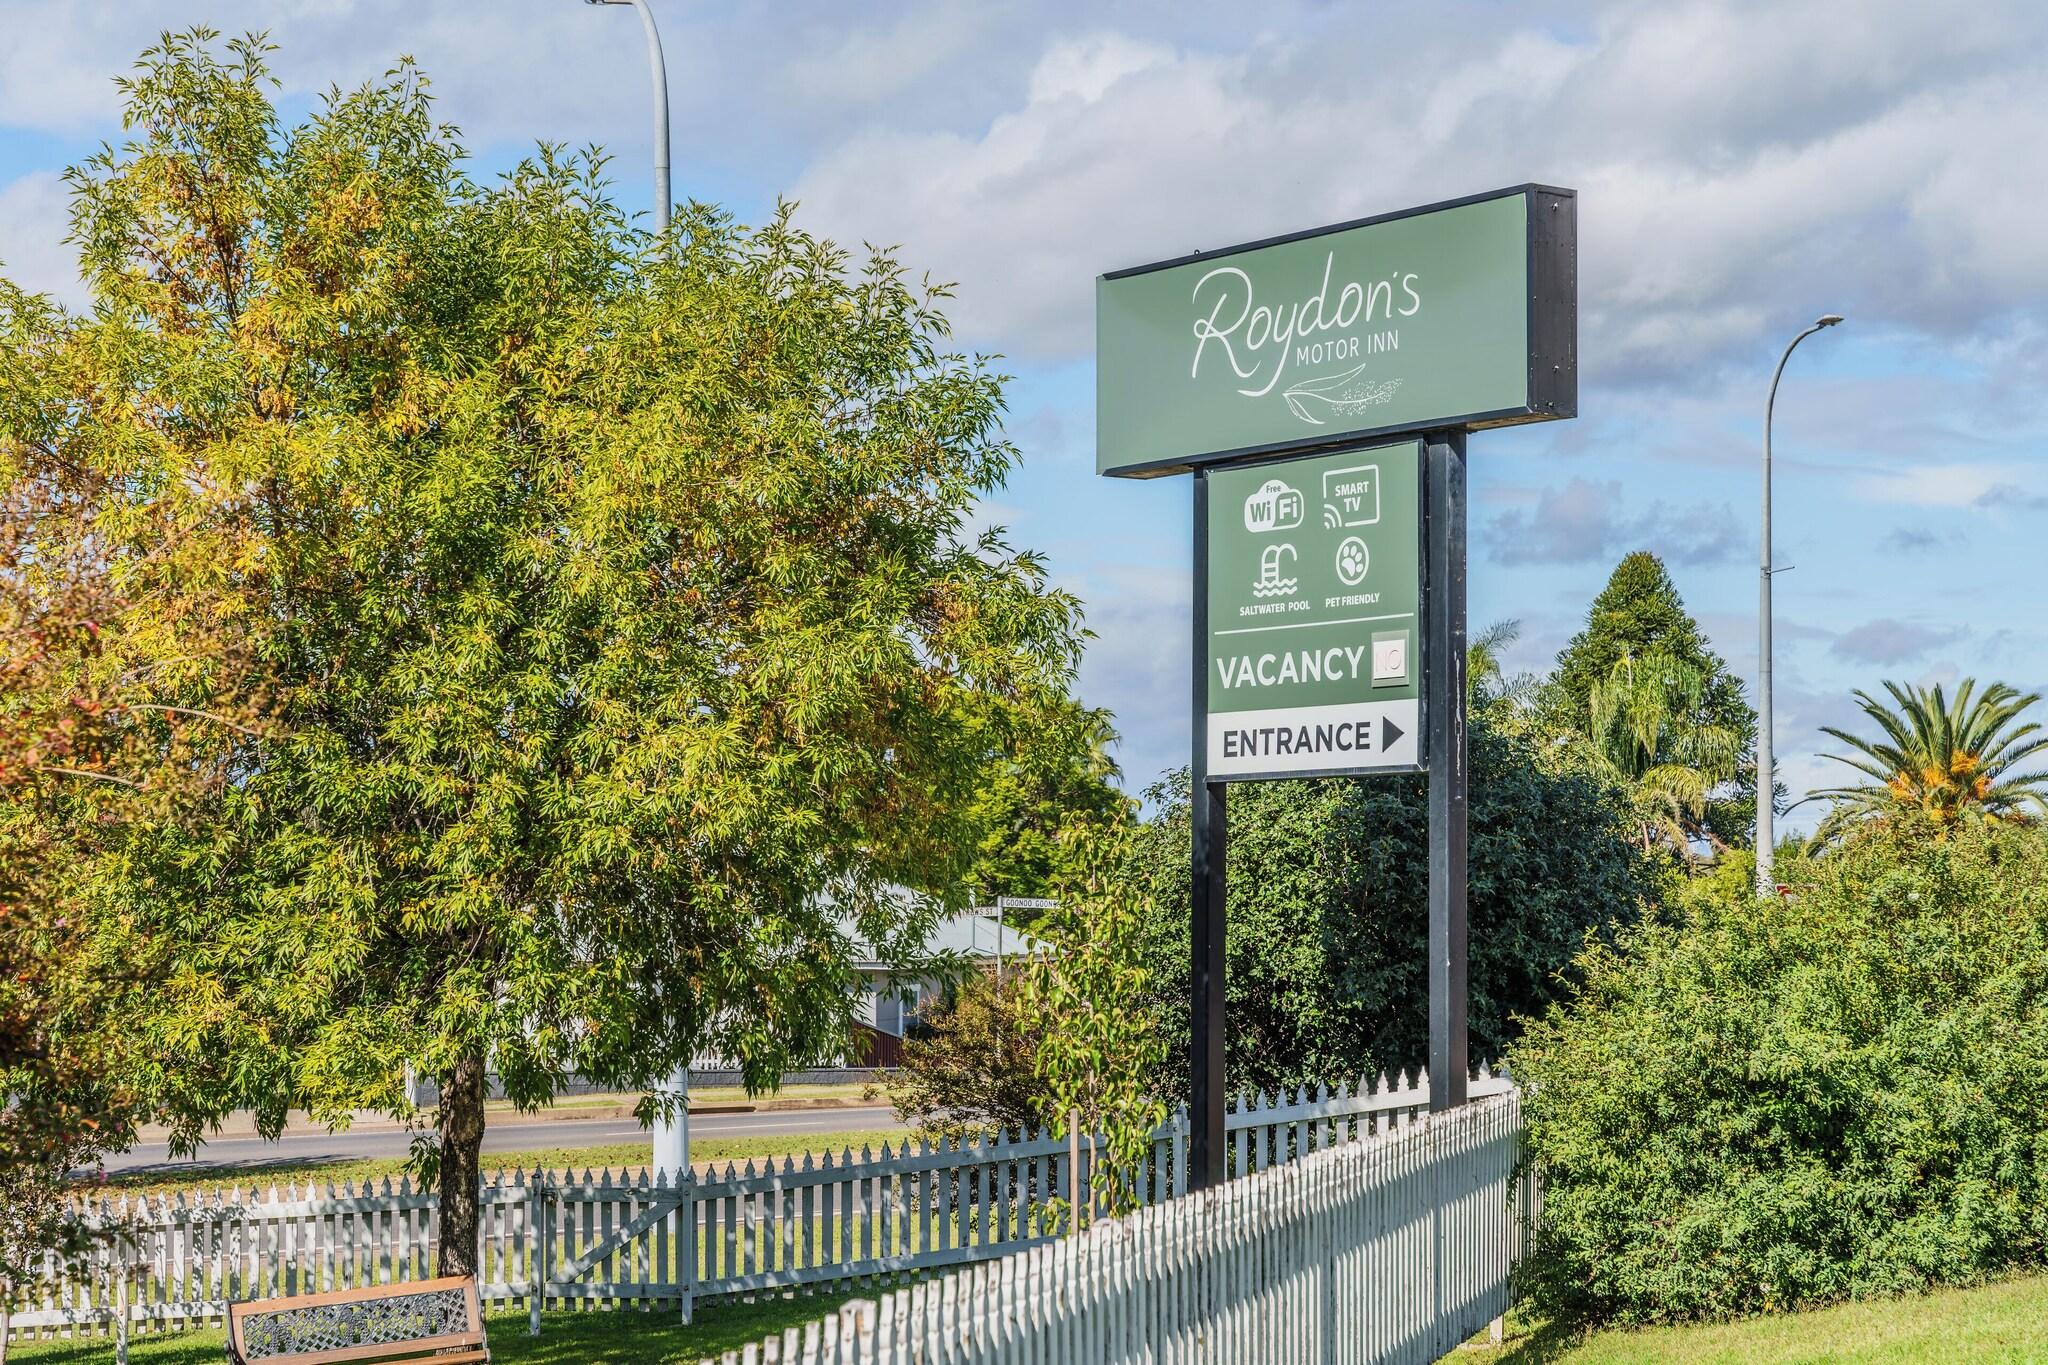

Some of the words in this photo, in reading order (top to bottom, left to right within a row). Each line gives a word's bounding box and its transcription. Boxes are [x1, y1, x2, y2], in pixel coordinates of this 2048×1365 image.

[1191, 250, 1421, 397] Roydon's
[1296, 338, 1360, 368] MOTOR
[1368, 329, 1400, 353] INN
[1265, 484, 1282, 494] Free
[1334, 480, 1370, 497] SMART
[1343, 497, 1361, 513] TV
[1239, 602, 1286, 617] SALTWATER
[1288, 599, 1311, 611] POOL
[1325, 596, 1341, 608] PET
[1341, 592, 1381, 606] FRIENDLY
[1216, 645, 1366, 690] VACANCY
[1223, 721, 1371, 758] ENTRANCE
